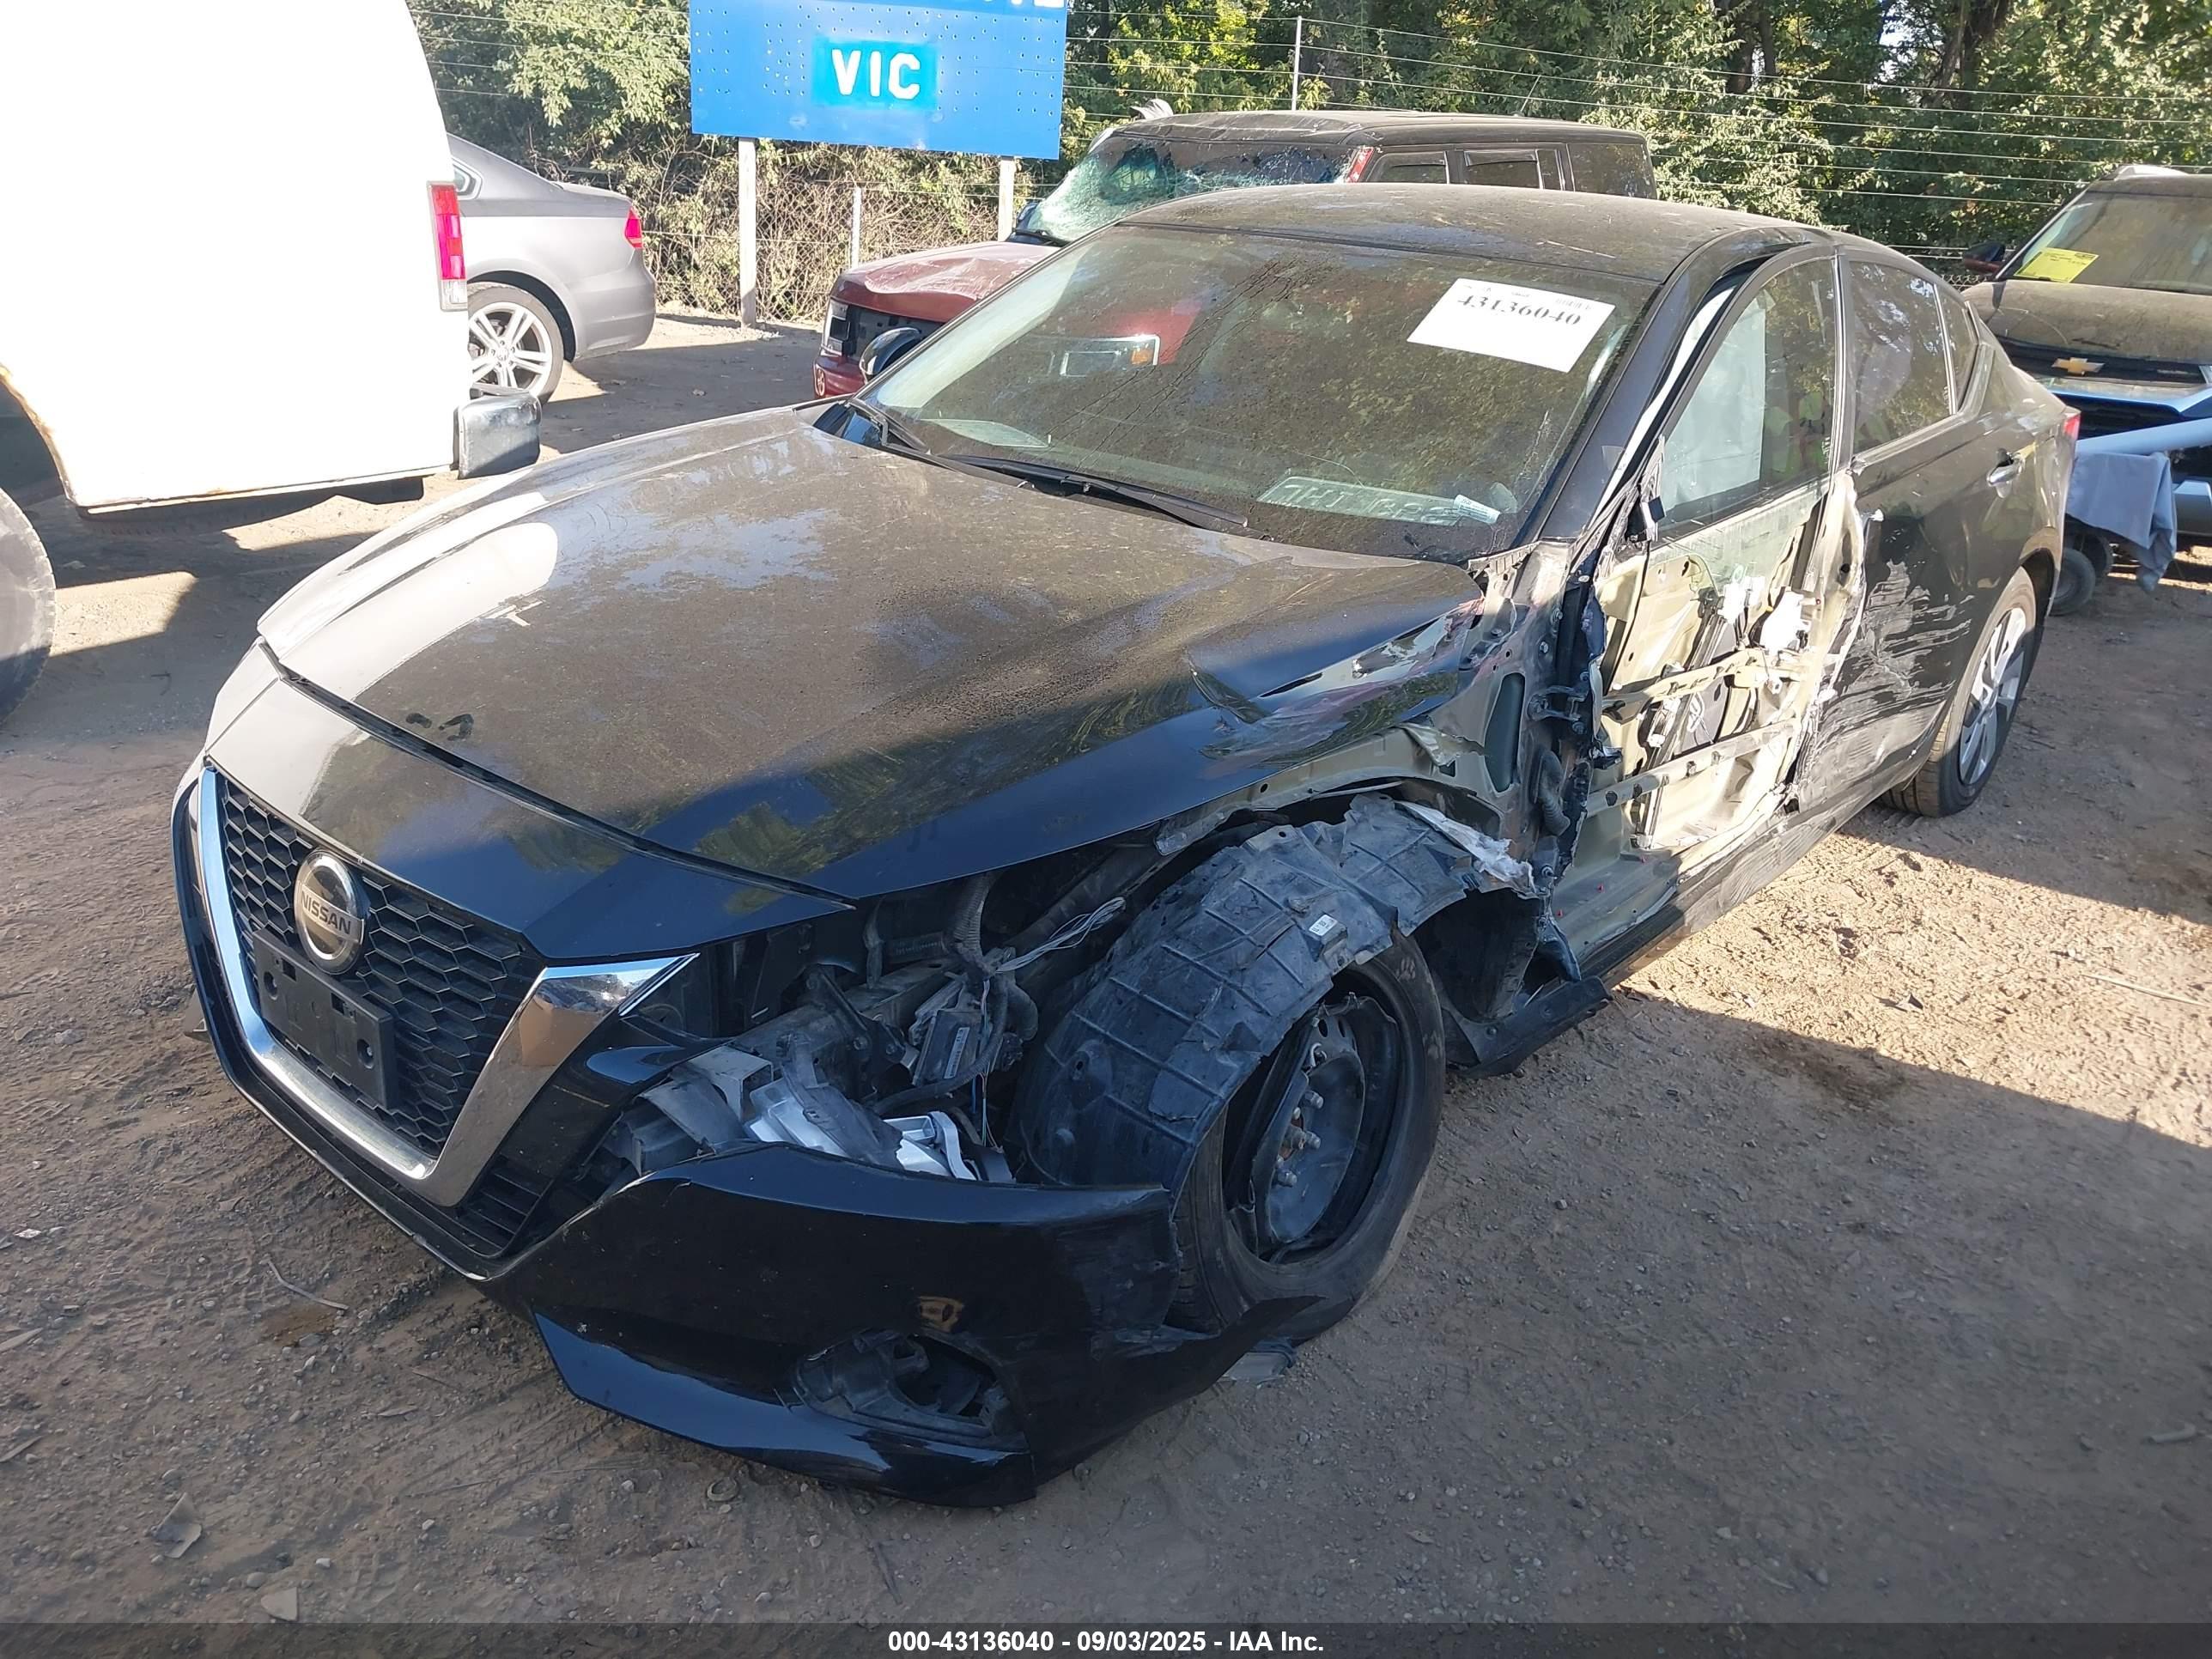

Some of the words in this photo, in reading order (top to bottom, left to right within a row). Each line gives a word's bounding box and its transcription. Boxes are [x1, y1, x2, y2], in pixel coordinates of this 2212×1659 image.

[831, 48, 921, 100] VIC
[1457, 294, 1582, 326] 43136040
[301, 890, 352, 935] NISSAN
